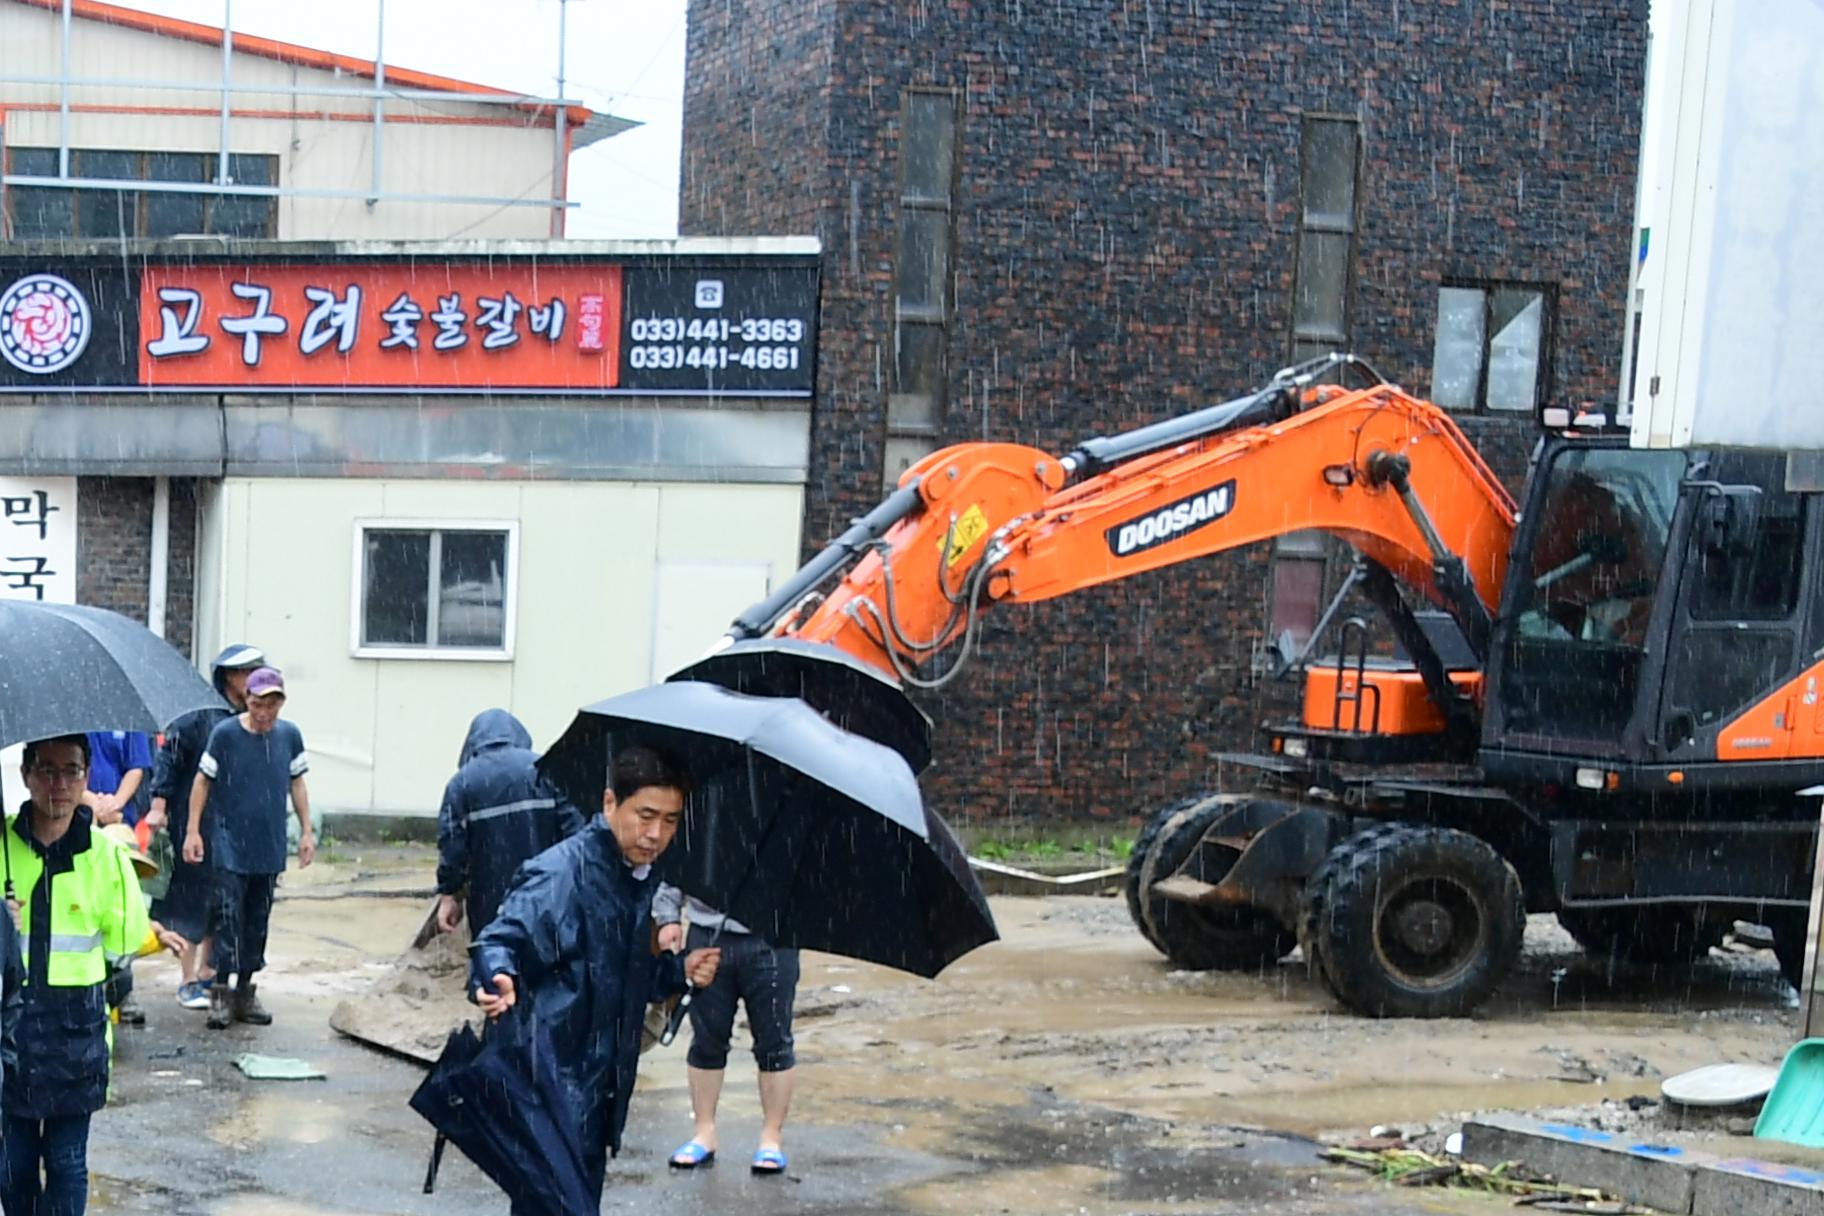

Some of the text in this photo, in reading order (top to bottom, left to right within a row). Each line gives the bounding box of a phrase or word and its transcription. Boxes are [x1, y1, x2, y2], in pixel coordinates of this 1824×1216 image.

[144, 281, 566, 365] 고구려 숯불갈비
[631, 318, 803, 342] 033)441-3363
[630, 345, 799, 370] 033)441-4661
[1118, 486, 1228, 554] DOOSAN
